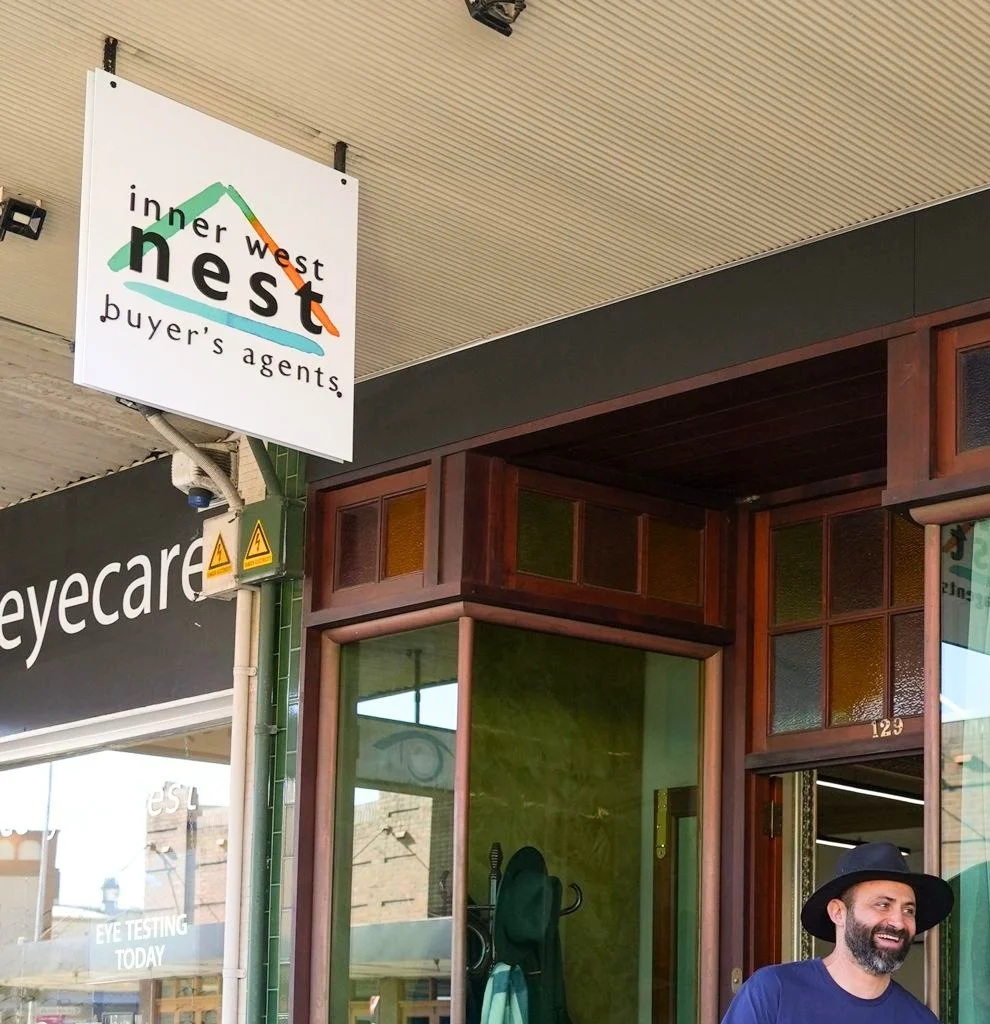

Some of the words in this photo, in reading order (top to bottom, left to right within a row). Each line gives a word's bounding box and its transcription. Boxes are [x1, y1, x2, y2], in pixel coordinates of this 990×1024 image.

[129, 184, 227, 243] inner
[245, 235, 325, 281] west
[129, 225, 324, 335] nest
[103, 294, 224, 355] buyer's
[243, 347, 339, 392] agents
[0, 537, 207, 669] eyecare
[871, 717, 904, 738] 129
[96, 922, 121, 944] EYE
[126, 913, 188, 941] TESTING
[115, 945, 166, 970] TODAY
